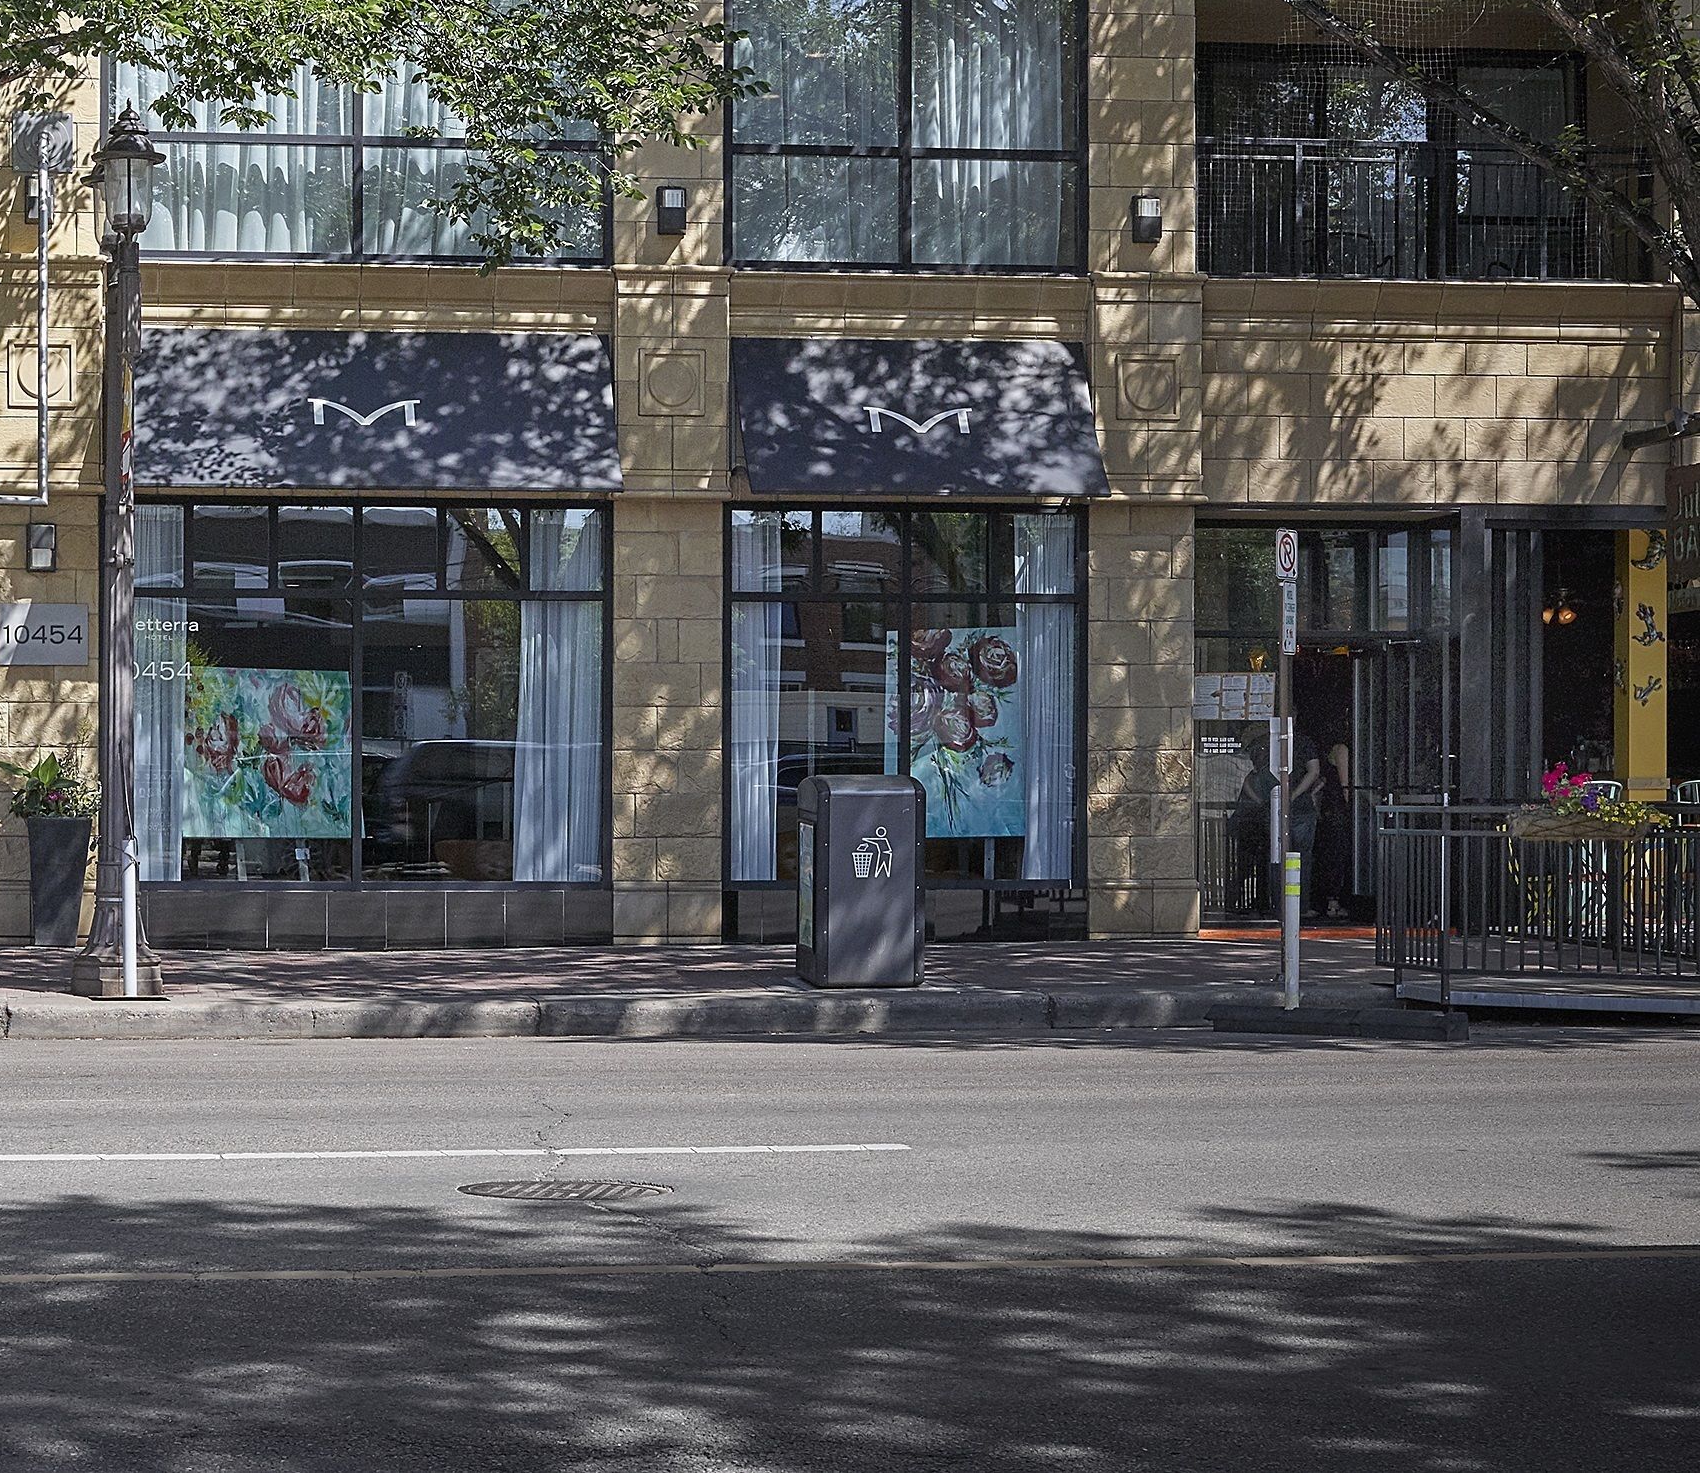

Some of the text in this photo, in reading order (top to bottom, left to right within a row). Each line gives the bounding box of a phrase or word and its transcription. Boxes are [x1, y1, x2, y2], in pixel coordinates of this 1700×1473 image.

[2, 624, 83, 644] 10454
[135, 618, 199, 632] etterra
[133, 660, 193, 681] 454
